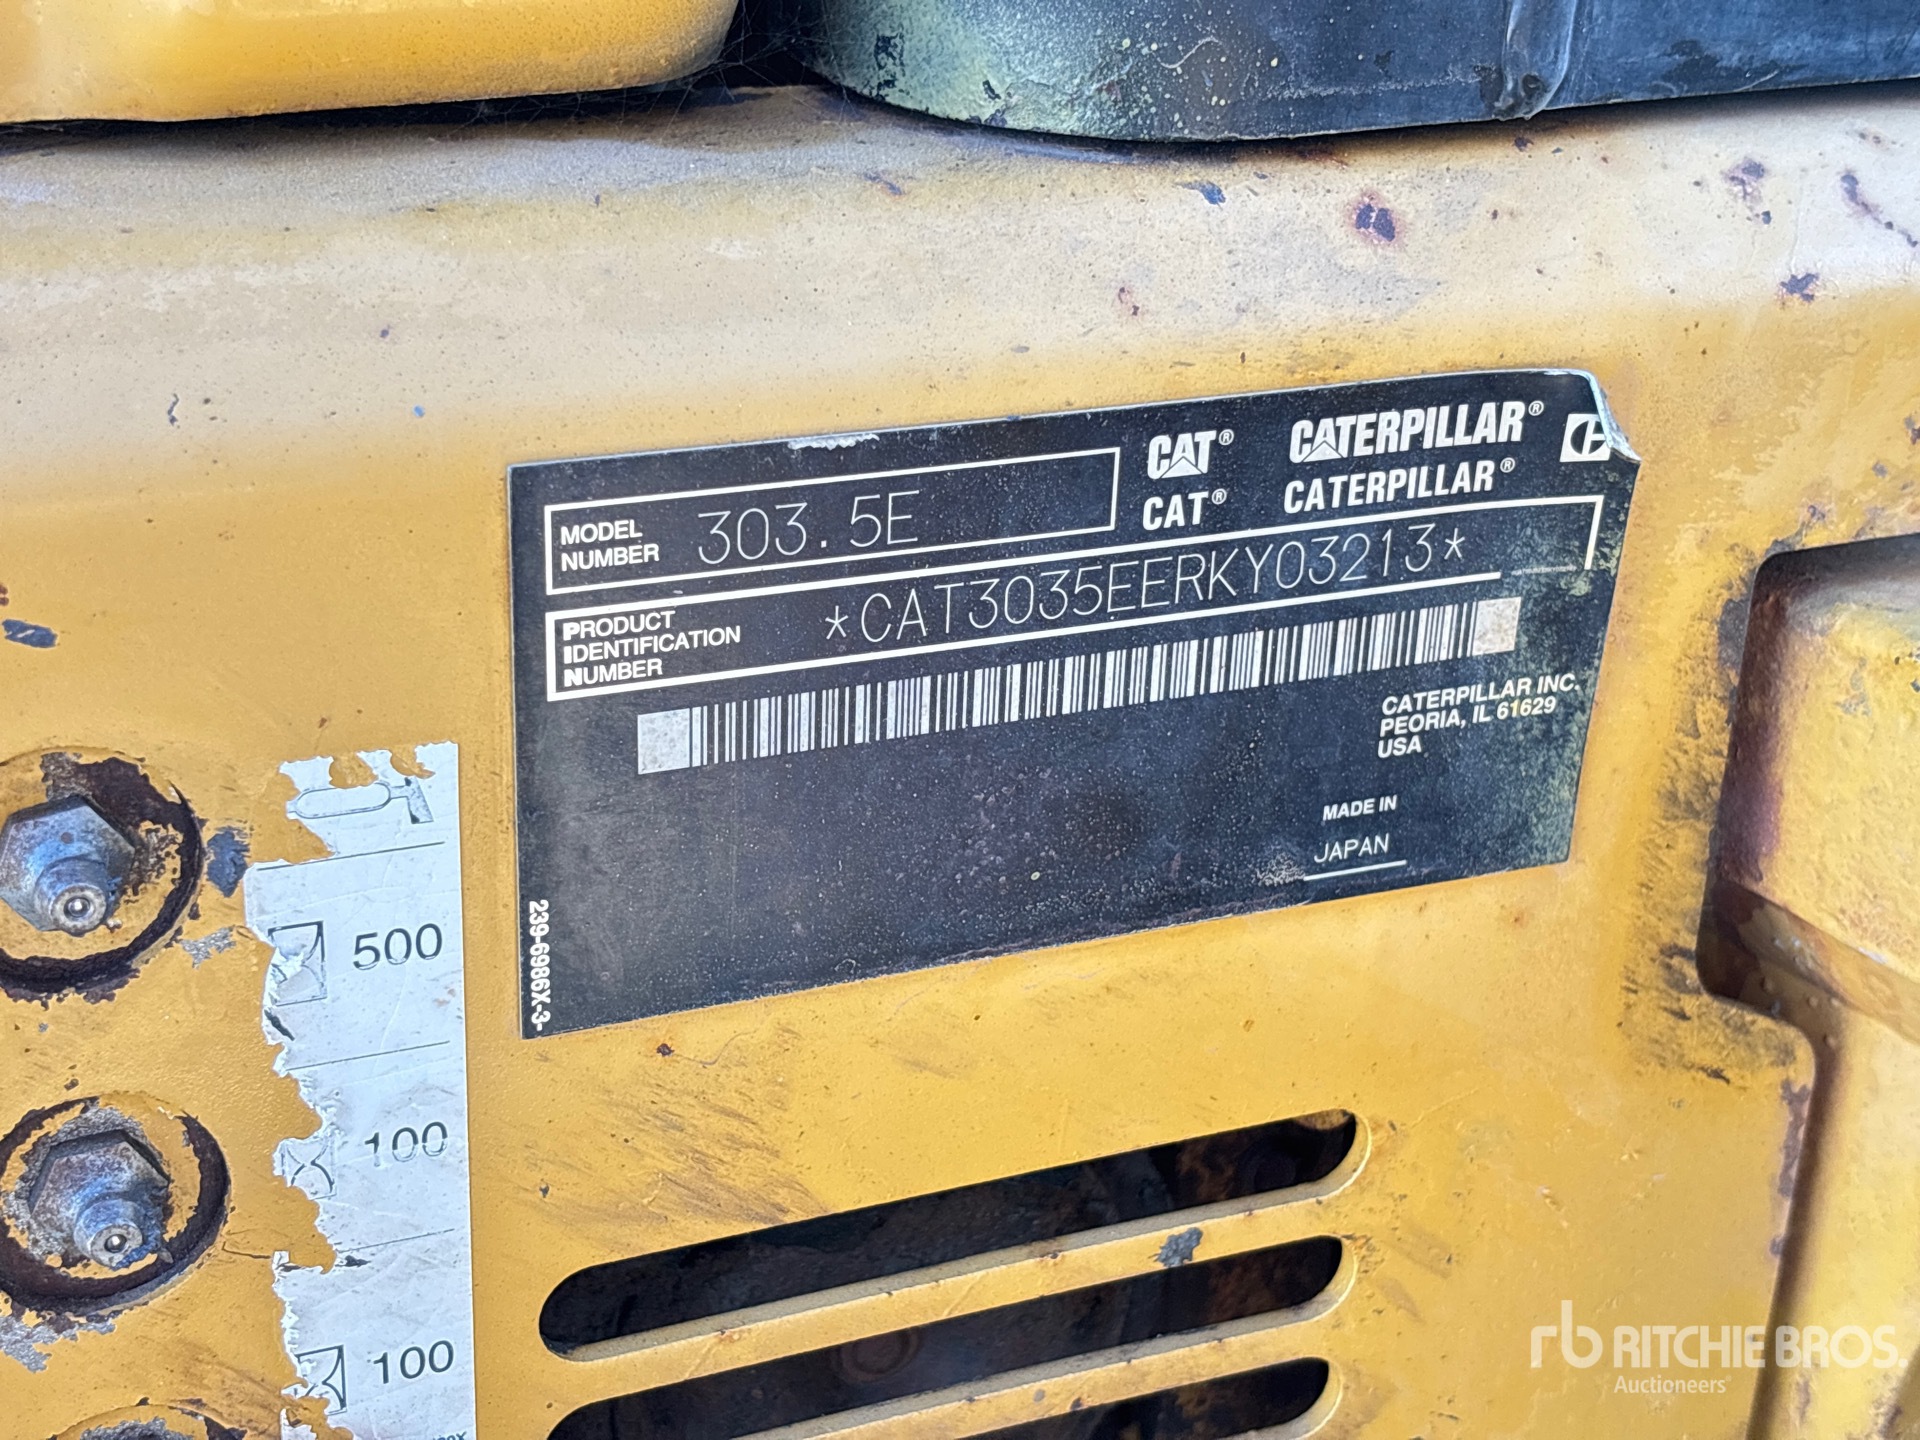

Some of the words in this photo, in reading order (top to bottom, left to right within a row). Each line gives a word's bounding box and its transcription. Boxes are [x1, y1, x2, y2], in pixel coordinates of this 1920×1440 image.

[560, 519, 642, 545] MODEL
[560, 543, 660, 572] NUMBER
[563, 610, 676, 641] PRODUCT
[563, 625, 742, 664] IDENTIFICATION
[563, 658, 663, 688] NUMBER
[1382, 677, 1532, 716] CATERPILLAR
[1536, 672, 1581, 694] INC.
[1379, 711, 1466, 738] PEORIA,
[1472, 705, 1491, 724] IL
[1496, 695, 1557, 720] 61629
[1377, 735, 1422, 759] USA
[1322, 798, 1375, 821] MADE
[1379, 795, 1398, 812] IN
[1313, 833, 1390, 863] JAPAN
[352, 923, 443, 971] 500
[364, 1121, 448, 1167] 100
[373, 1340, 454, 1385] 100
